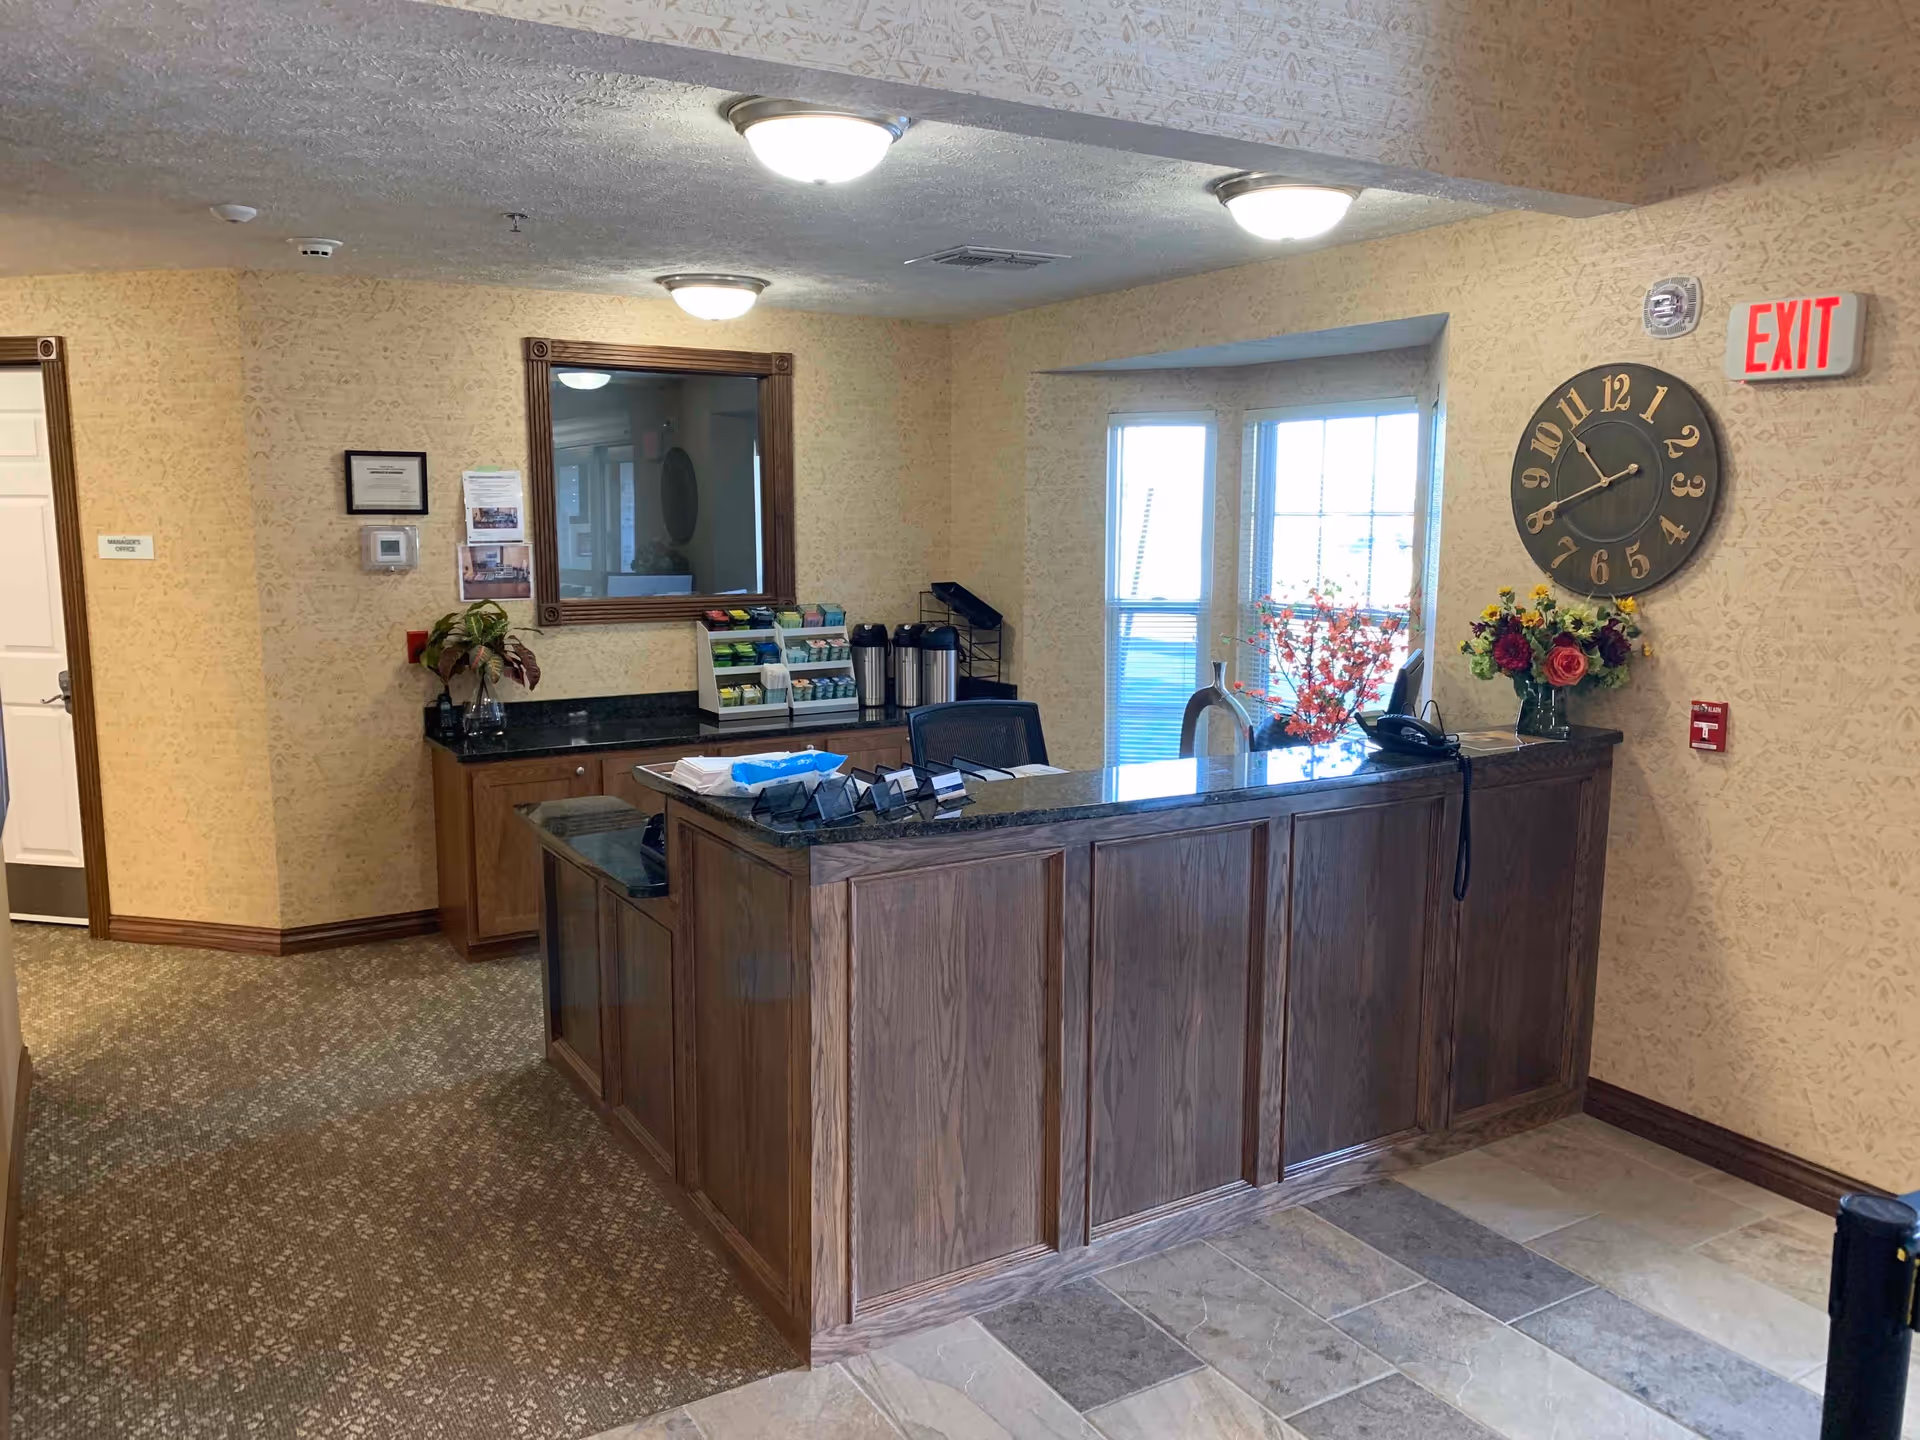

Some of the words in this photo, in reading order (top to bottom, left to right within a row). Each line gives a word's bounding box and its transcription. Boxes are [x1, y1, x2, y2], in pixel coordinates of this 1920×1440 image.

[1745, 296, 1841, 373] EXIT
[1556, 387, 1593, 430] 11
[1600, 373, 1631, 412] 12
[1639, 385, 1669, 424] 1
[1530, 421, 1564, 463] 10
[1663, 424, 1701, 459] 2
[1521, 467, 1550, 489] 9
[1670, 472, 1706, 498] 3
[1525, 503, 1555, 535] 8
[1659, 515, 1691, 545] 4
[1551, 536, 1580, 569] 7
[1590, 549, 1610, 585] 6
[1625, 540, 1650, 579] 5
